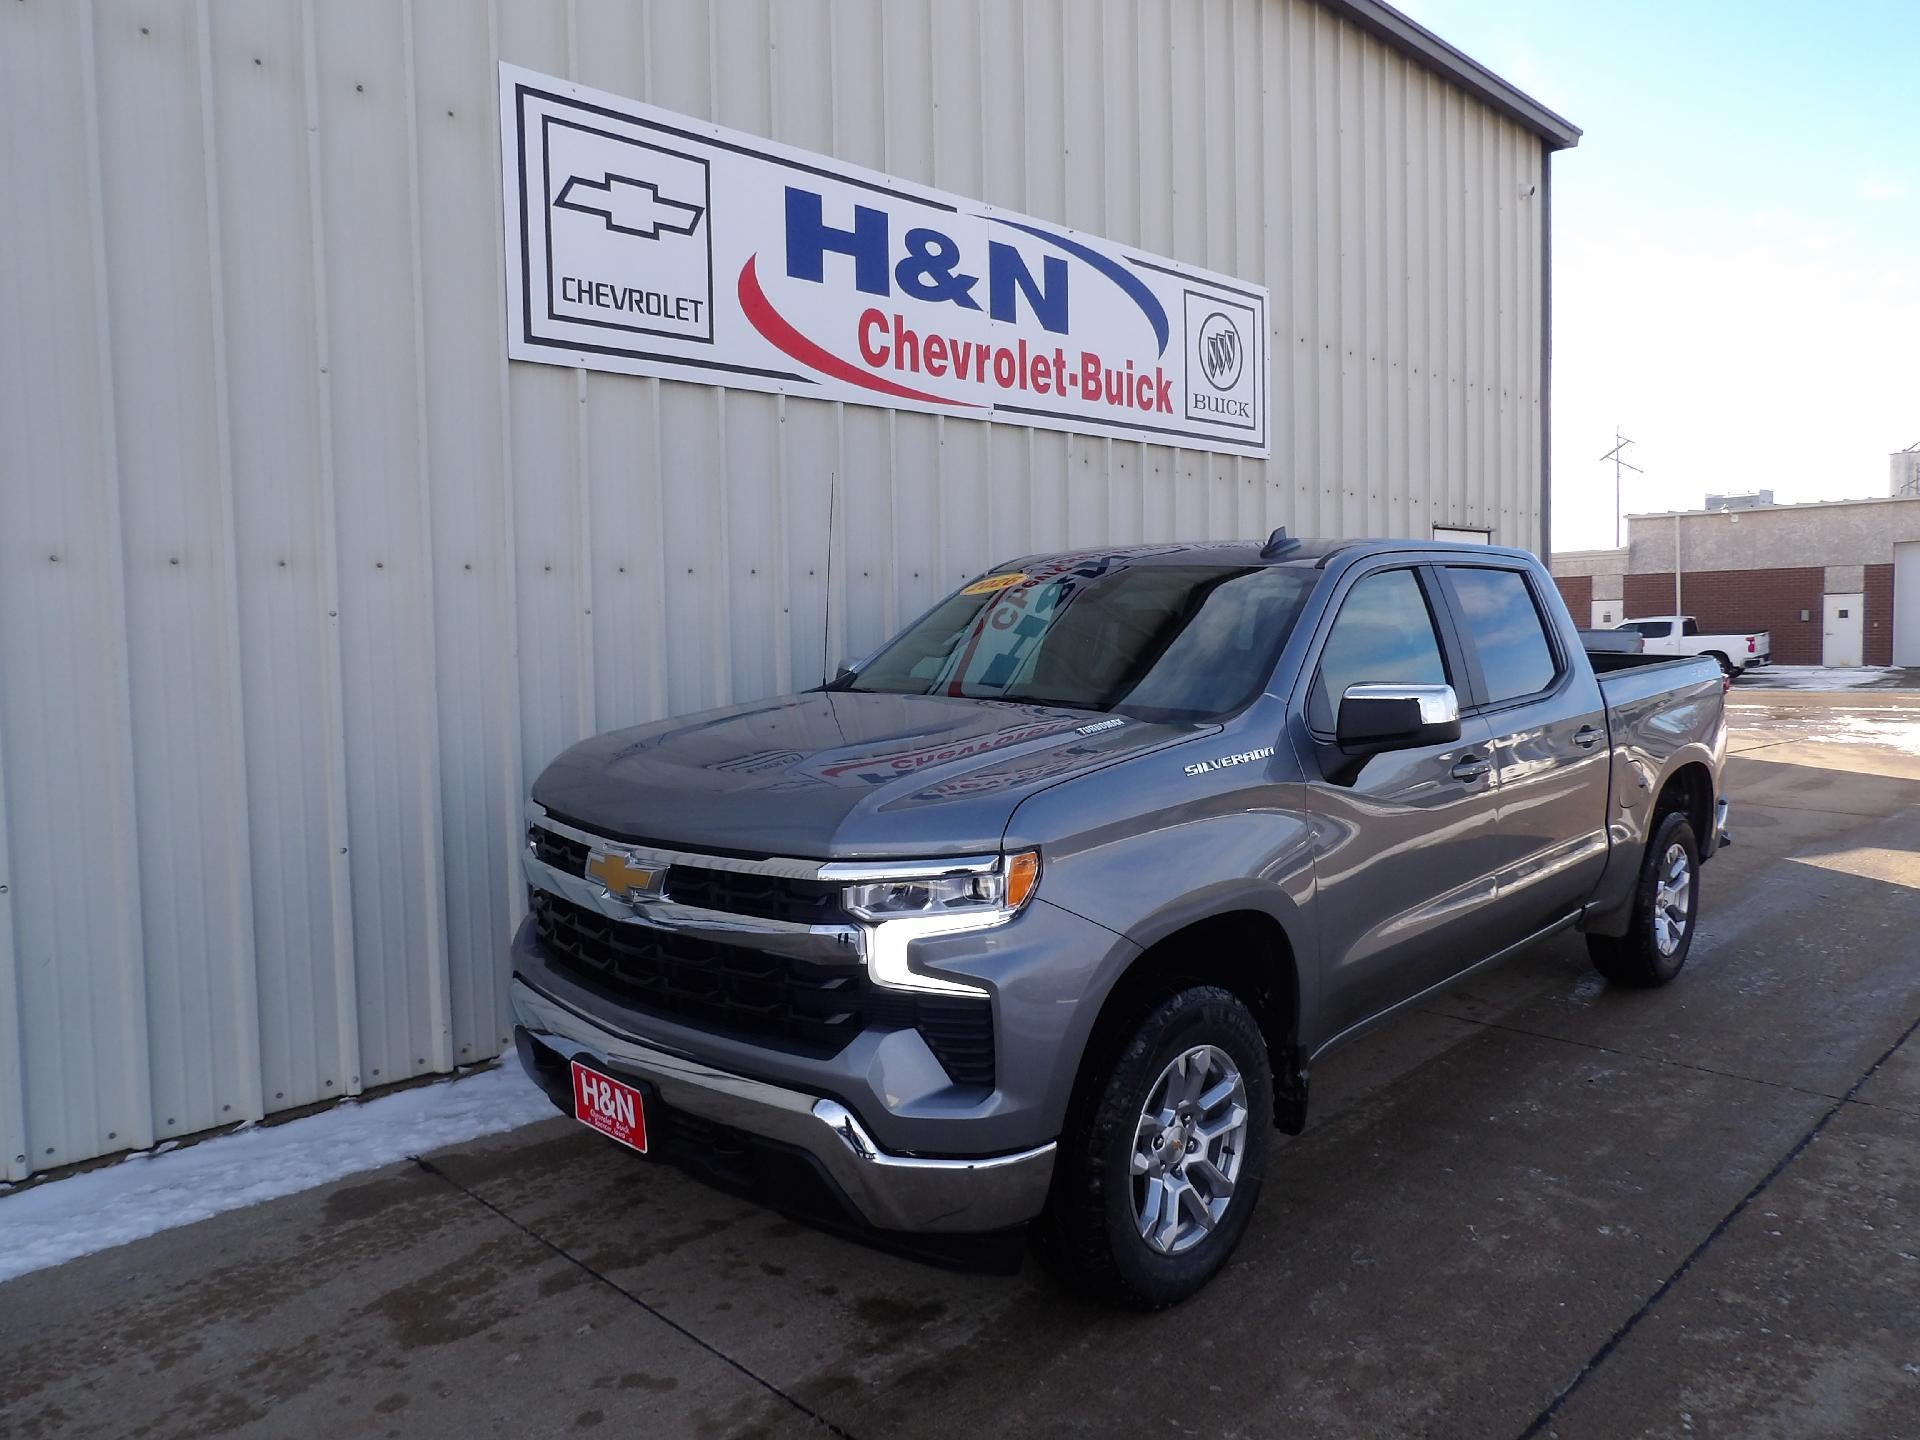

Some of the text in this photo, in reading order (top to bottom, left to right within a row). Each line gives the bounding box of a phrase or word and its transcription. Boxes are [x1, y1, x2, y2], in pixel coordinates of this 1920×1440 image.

[785, 185, 1069, 335] H&N
[562, 276, 704, 324] CHEVROLET
[857, 308, 1174, 414] Chevrolet-Buick
[1192, 392, 1251, 419] BUICK
[1184, 746, 1276, 777] SILVERADO
[580, 1072, 636, 1129] H&N
